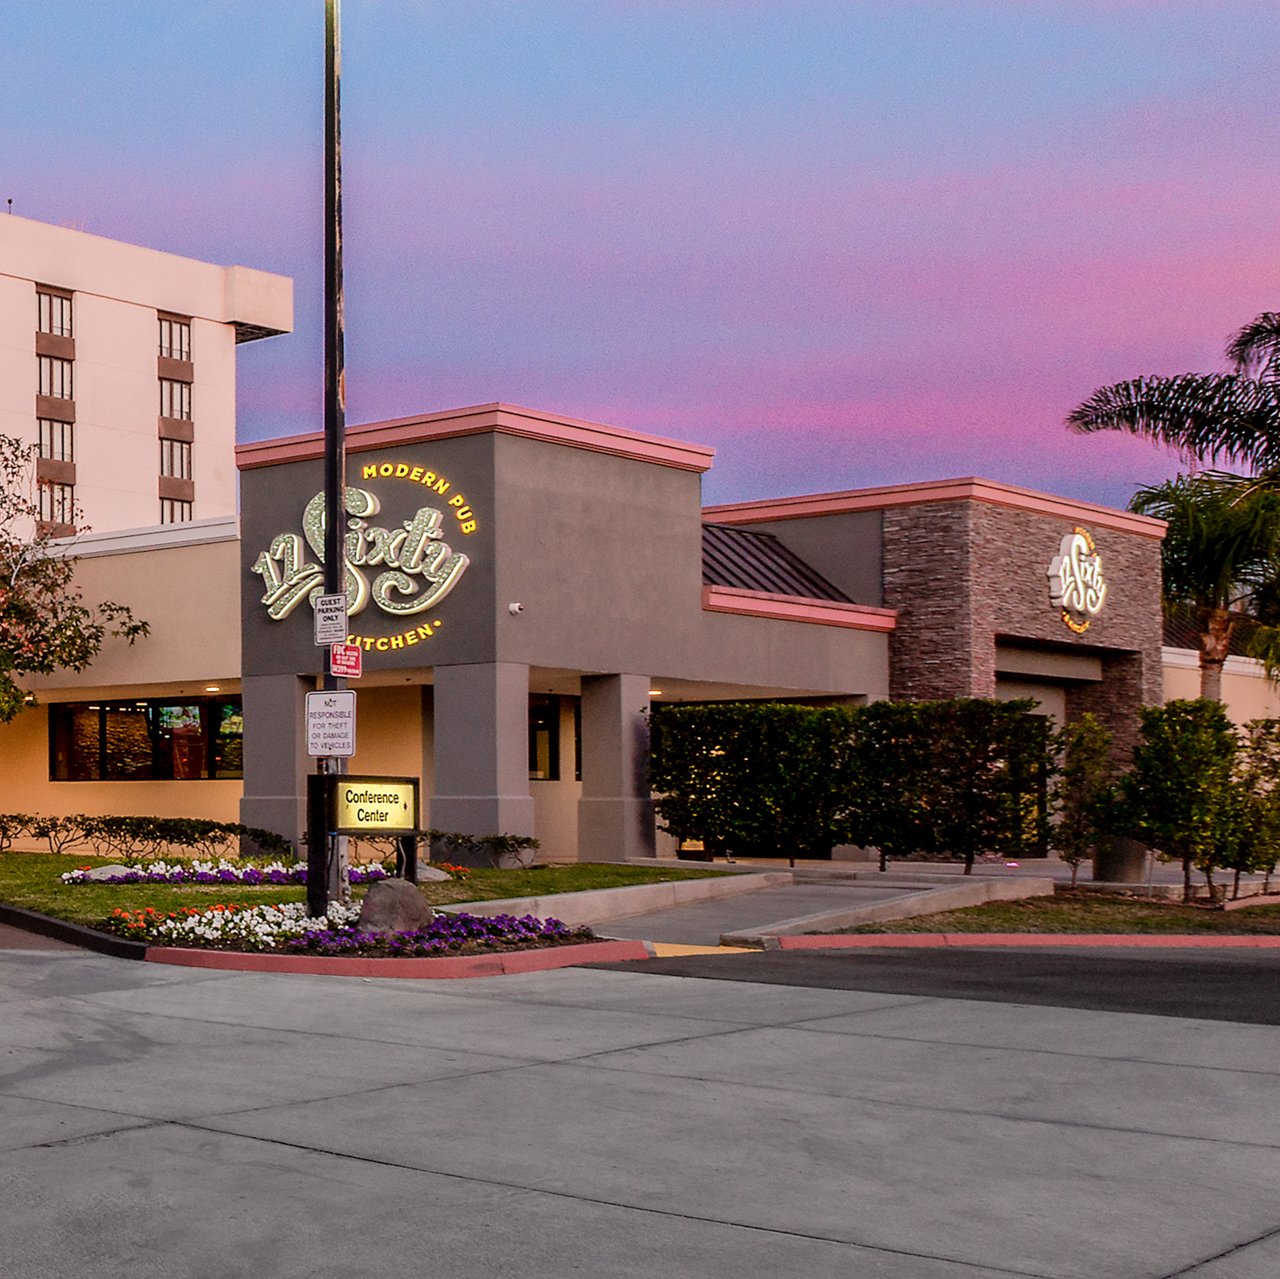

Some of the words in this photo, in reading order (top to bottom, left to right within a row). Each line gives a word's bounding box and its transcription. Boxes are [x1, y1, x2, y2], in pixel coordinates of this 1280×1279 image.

[361, 463, 451, 496] MODERN
[447, 493, 478, 536] PUB
[320, 598, 341, 607] GUEST
[317, 605, 345, 615] PARKING
[322, 614, 339, 622] ONLY
[344, 622, 435, 652] KITCHEN
[324, 699, 337, 708] NOT
[310, 710, 352, 719] RESPONSIBLE
[312, 722, 326, 730] FOR
[328, 721, 348, 729] THEFT
[311, 732, 321, 740] OR
[322, 731, 350, 739] DAMAGE
[320, 741, 351, 750] VEHICLES
[345, 789, 400, 804] Conference
[357, 808, 389, 822] Center
